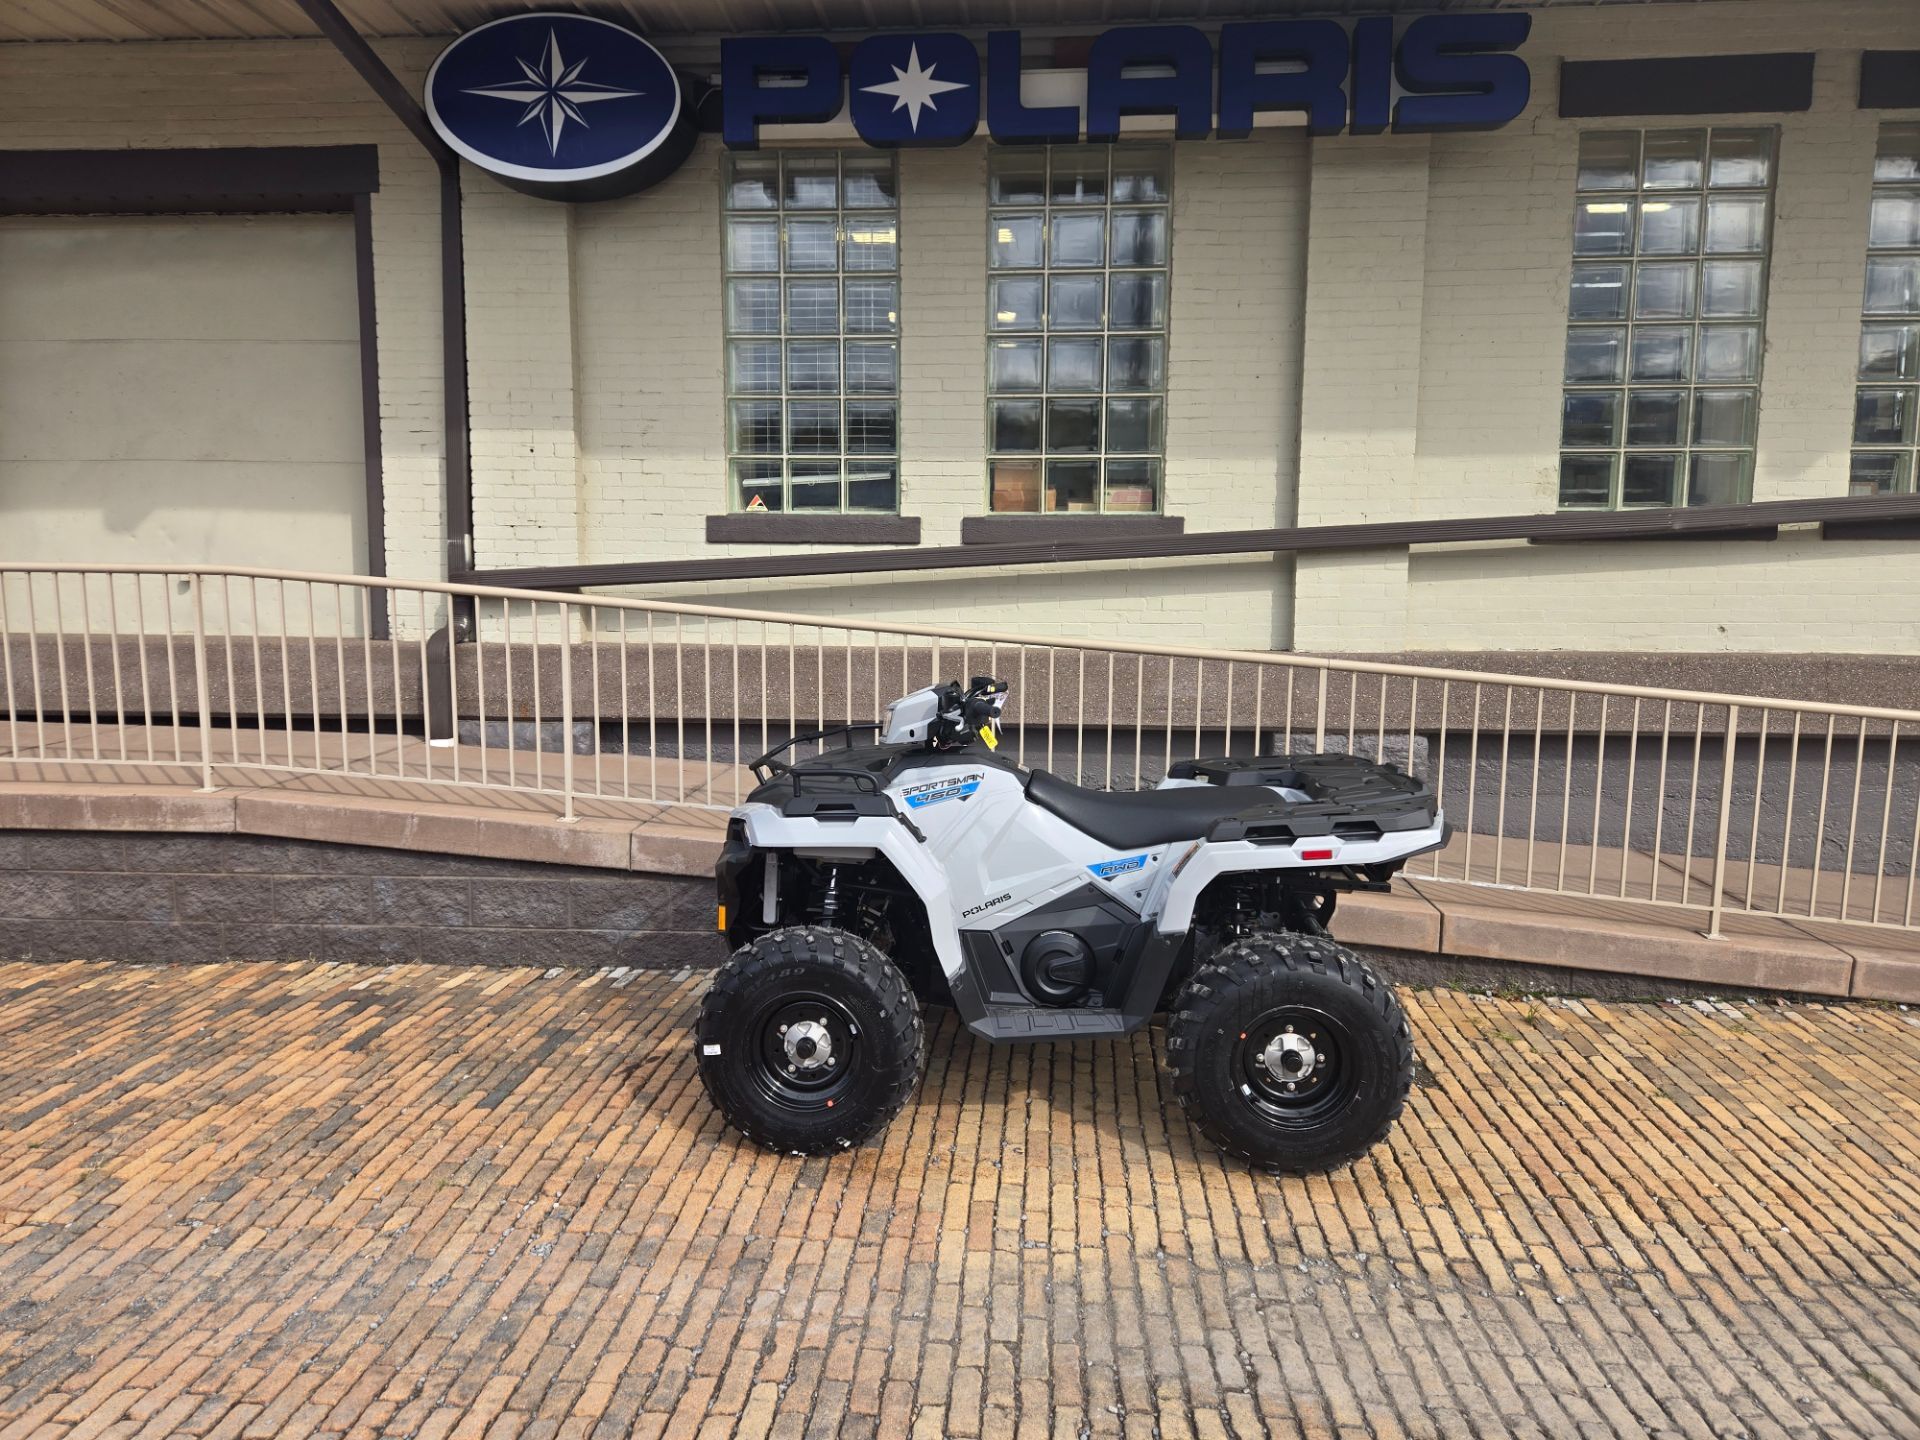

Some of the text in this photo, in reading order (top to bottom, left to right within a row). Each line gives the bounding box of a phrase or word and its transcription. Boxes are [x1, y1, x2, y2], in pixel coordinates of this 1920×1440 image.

[721, 13, 1531, 150] POLARIS
[900, 773, 985, 796] SPORTSMAN
[916, 787, 962, 803] 450
[1099, 861, 1140, 875] AWD
[962, 893, 1012, 918] POLARIS
